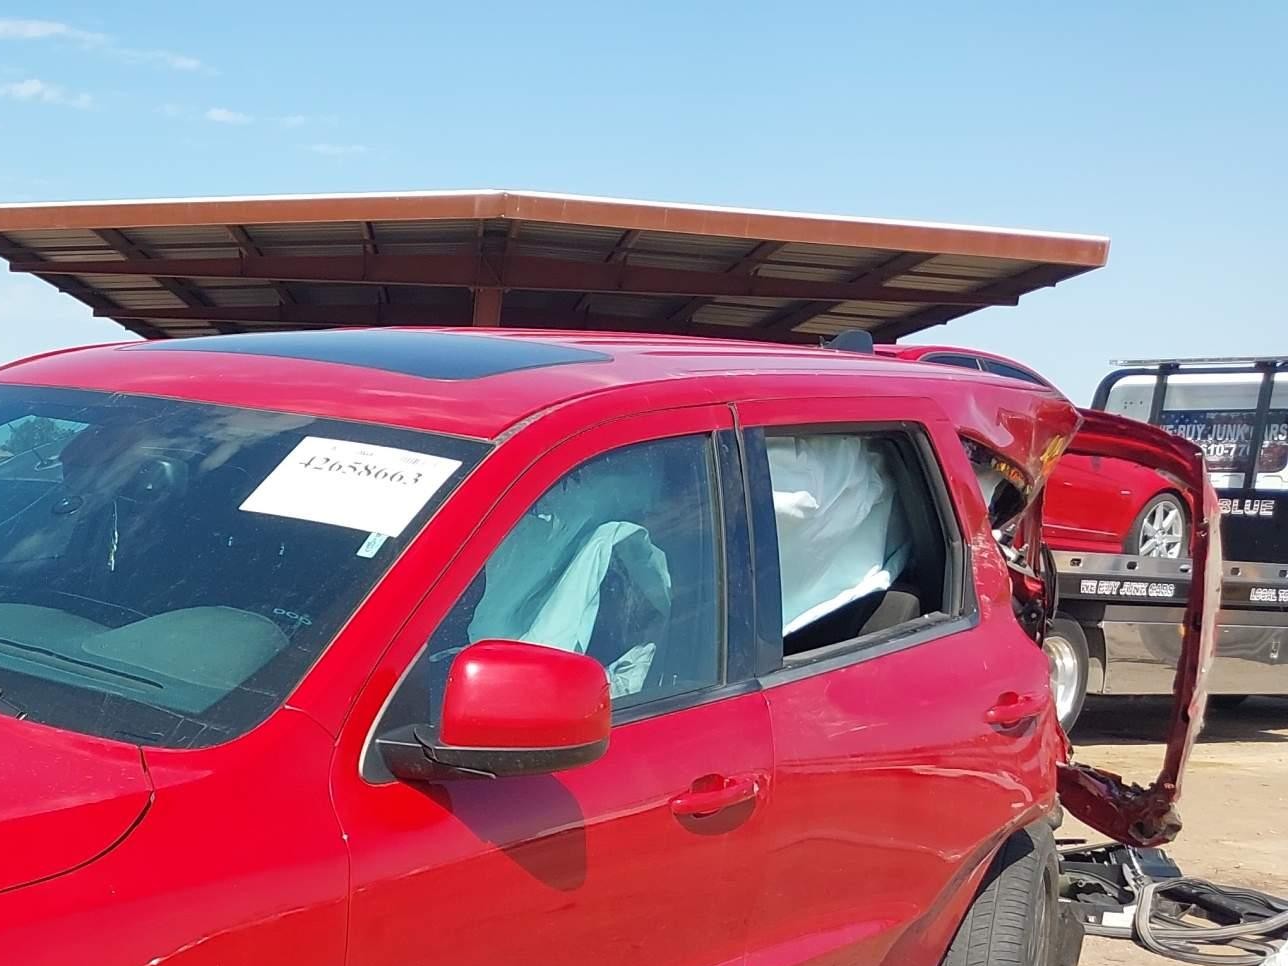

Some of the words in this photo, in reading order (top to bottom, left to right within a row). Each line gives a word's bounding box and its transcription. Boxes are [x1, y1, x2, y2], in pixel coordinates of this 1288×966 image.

[1177, 424, 1206, 440] BUY
[1208, 424, 1248, 441] JUNK
[299, 456, 424, 486] 42658663
[1219, 498, 1275, 516] BLUE
[1080, 579, 1097, 594] WE
[1097, 580, 1120, 596] BUY
[1119, 581, 1149, 596] JUNK
[1148, 583, 1175, 598] CARS
[1249, 587, 1278, 602] LOCAL
